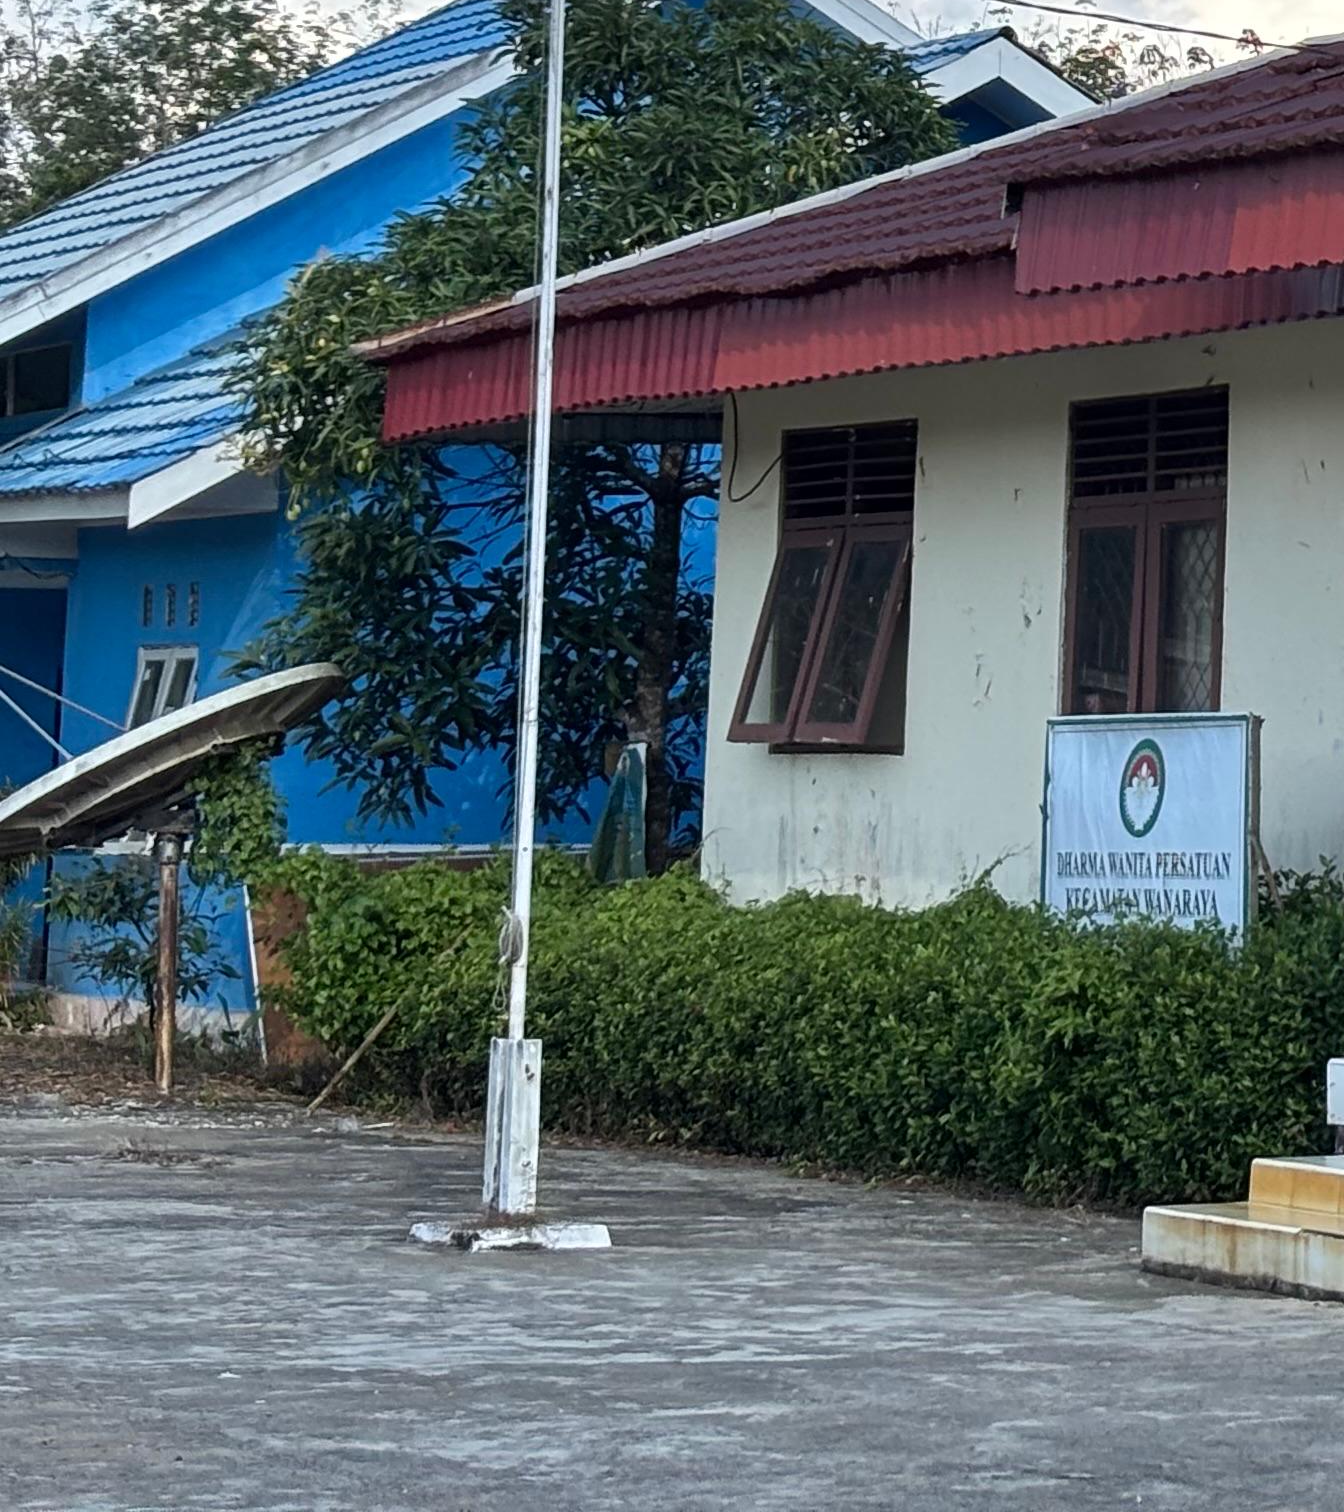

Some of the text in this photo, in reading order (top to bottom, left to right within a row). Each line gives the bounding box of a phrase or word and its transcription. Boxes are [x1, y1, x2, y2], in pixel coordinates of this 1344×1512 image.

[1056, 851, 1232, 879] DHARMA WANITA PERSATUAN
[1144, 888, 1219, 917] WANARAYA
